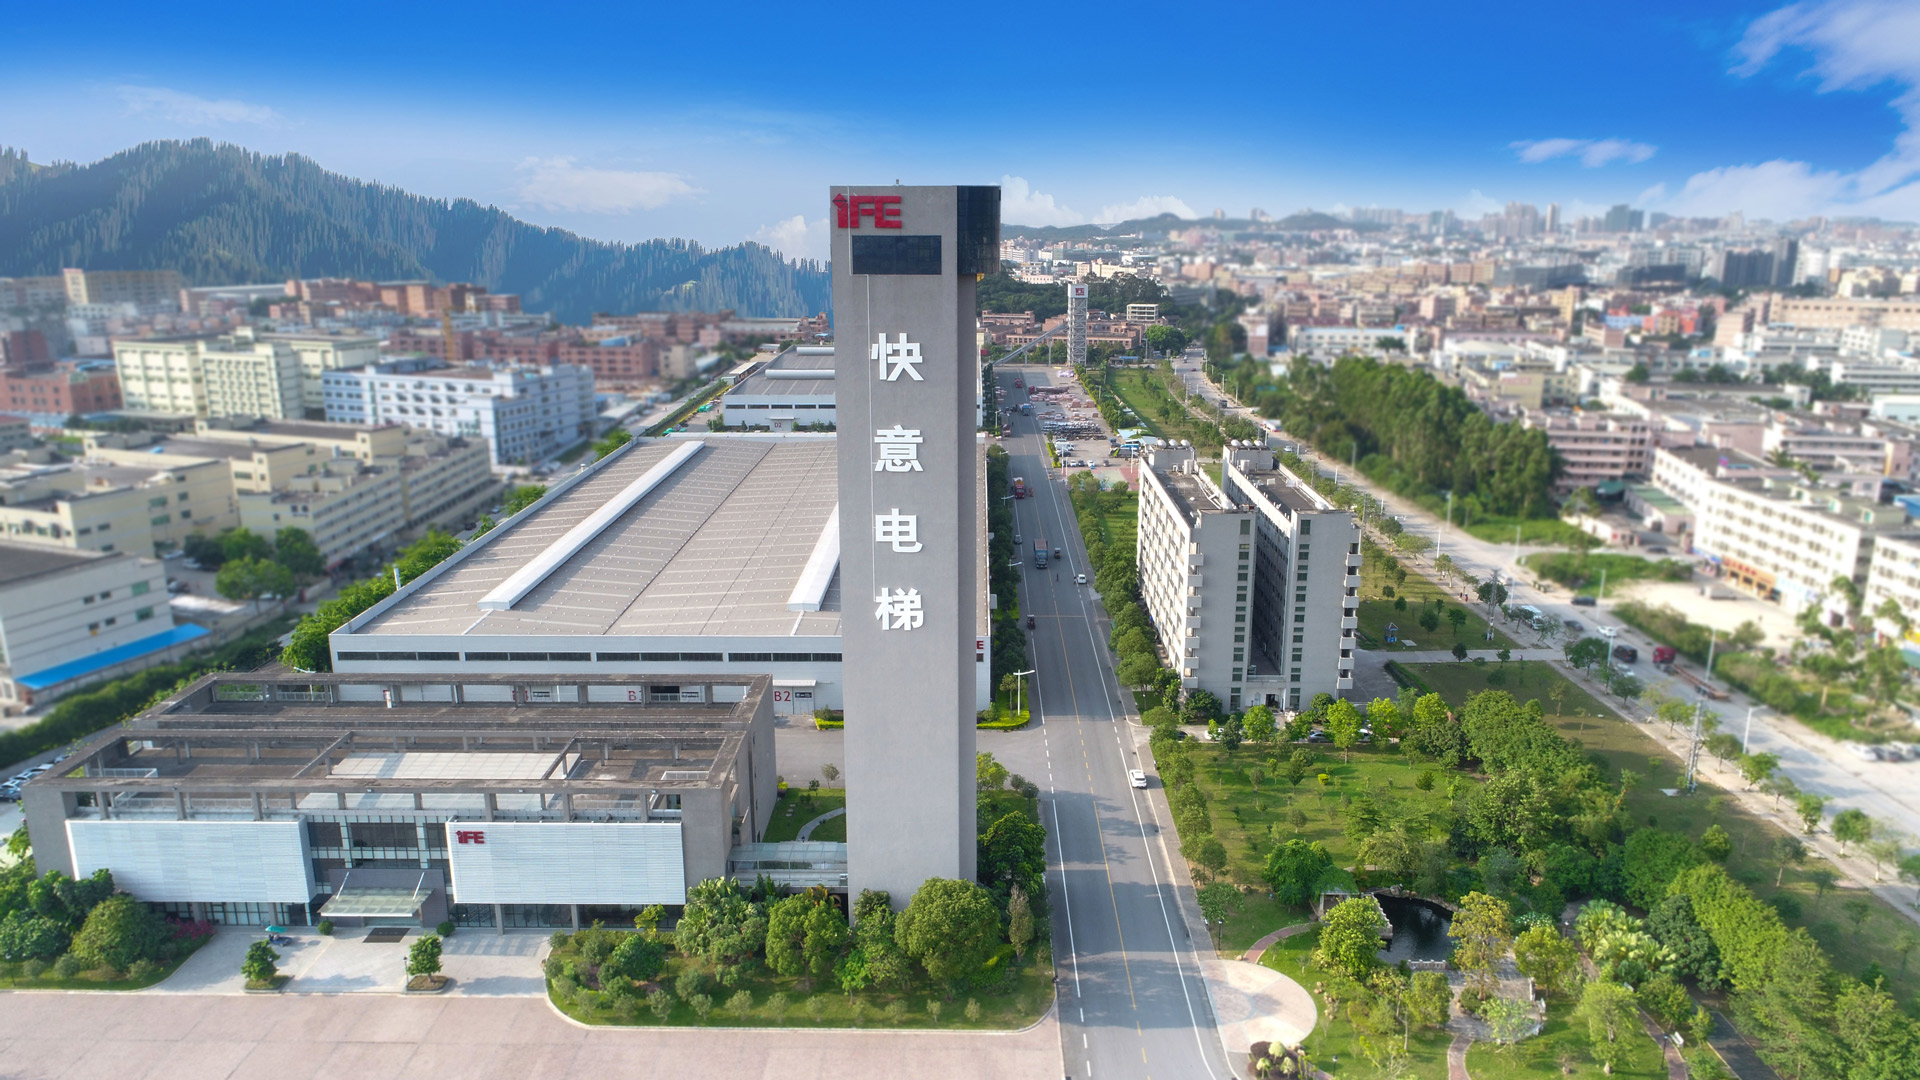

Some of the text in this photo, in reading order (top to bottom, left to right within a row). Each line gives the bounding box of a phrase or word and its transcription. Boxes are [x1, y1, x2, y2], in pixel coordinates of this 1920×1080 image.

[871, 332, 924, 631] 快意电梯
[774, 690, 791, 702] B2
